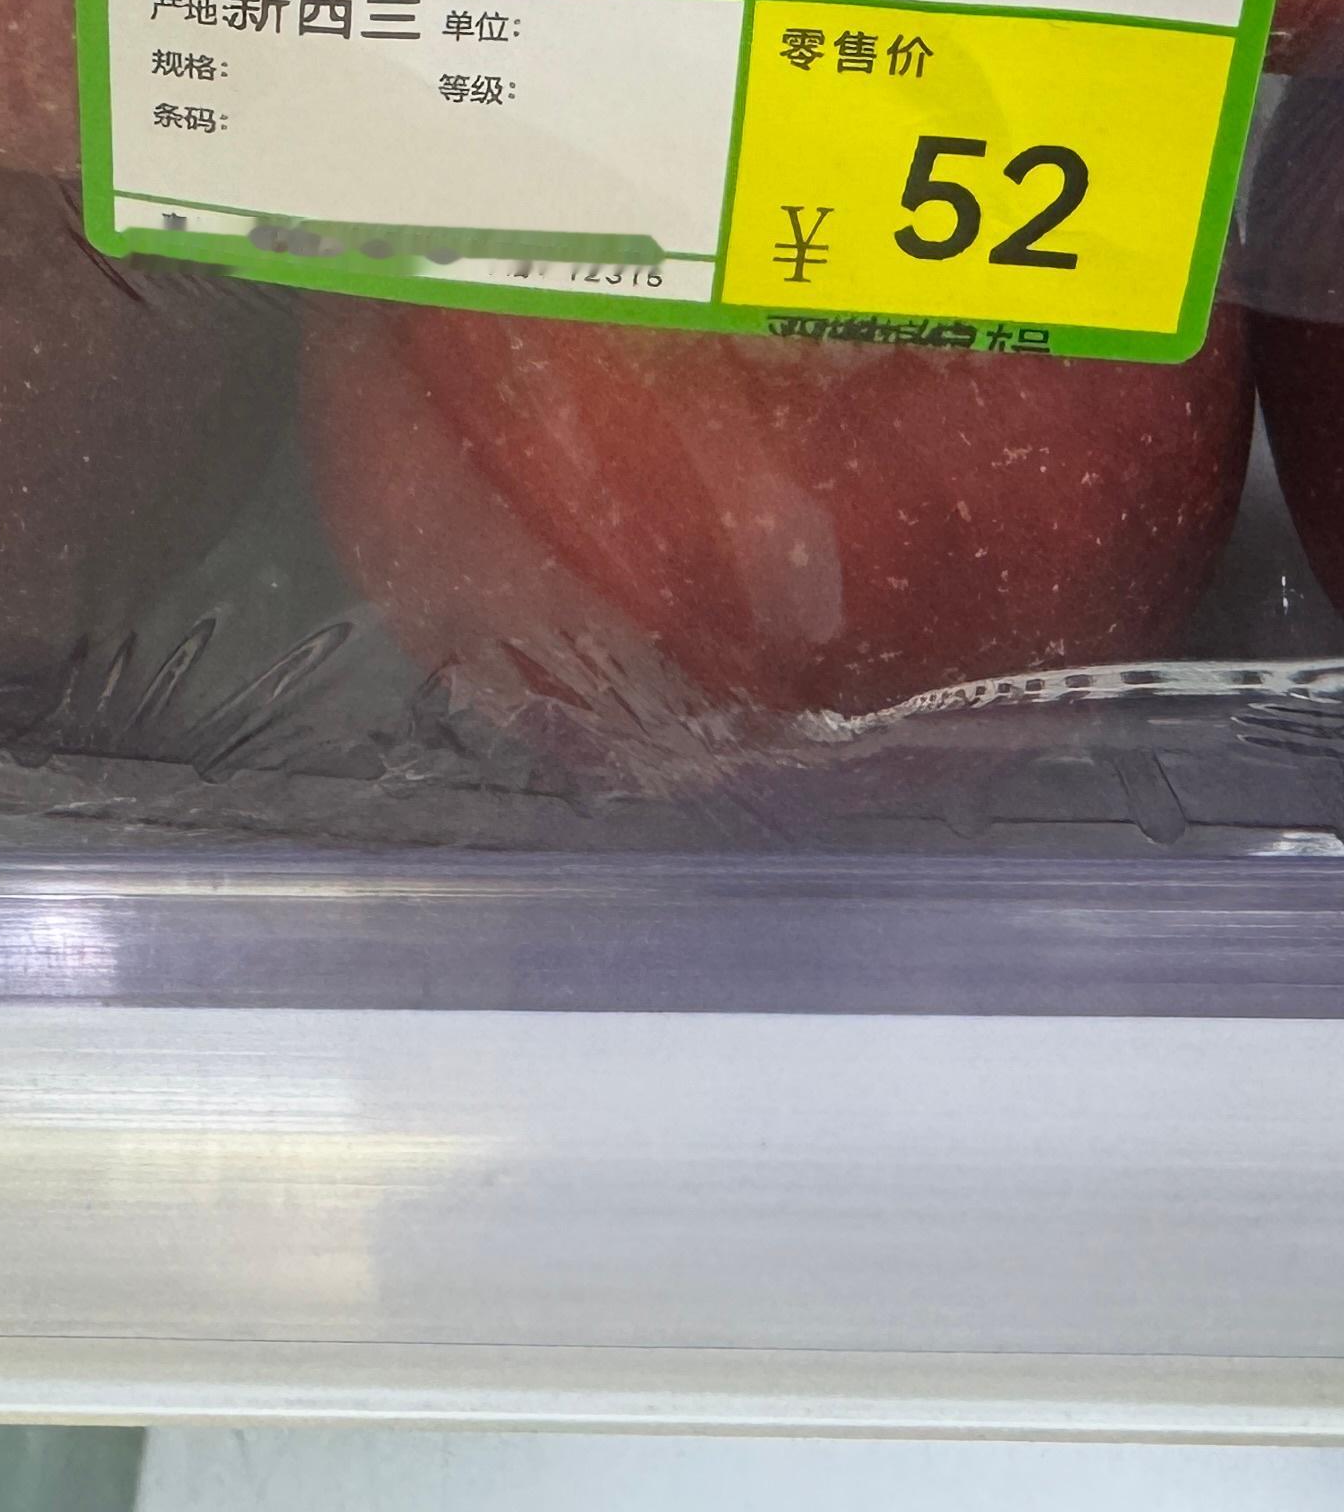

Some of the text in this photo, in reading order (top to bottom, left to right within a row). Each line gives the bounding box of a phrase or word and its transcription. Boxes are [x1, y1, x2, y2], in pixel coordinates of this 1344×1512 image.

[441, 10, 522, 42] 单位：
[151, 48, 516, 106] 规格： 等级：
[779, 28, 935, 78] 零售价
[153, 102, 229, 134] 条码：
[893, 135, 1090, 270] 52
